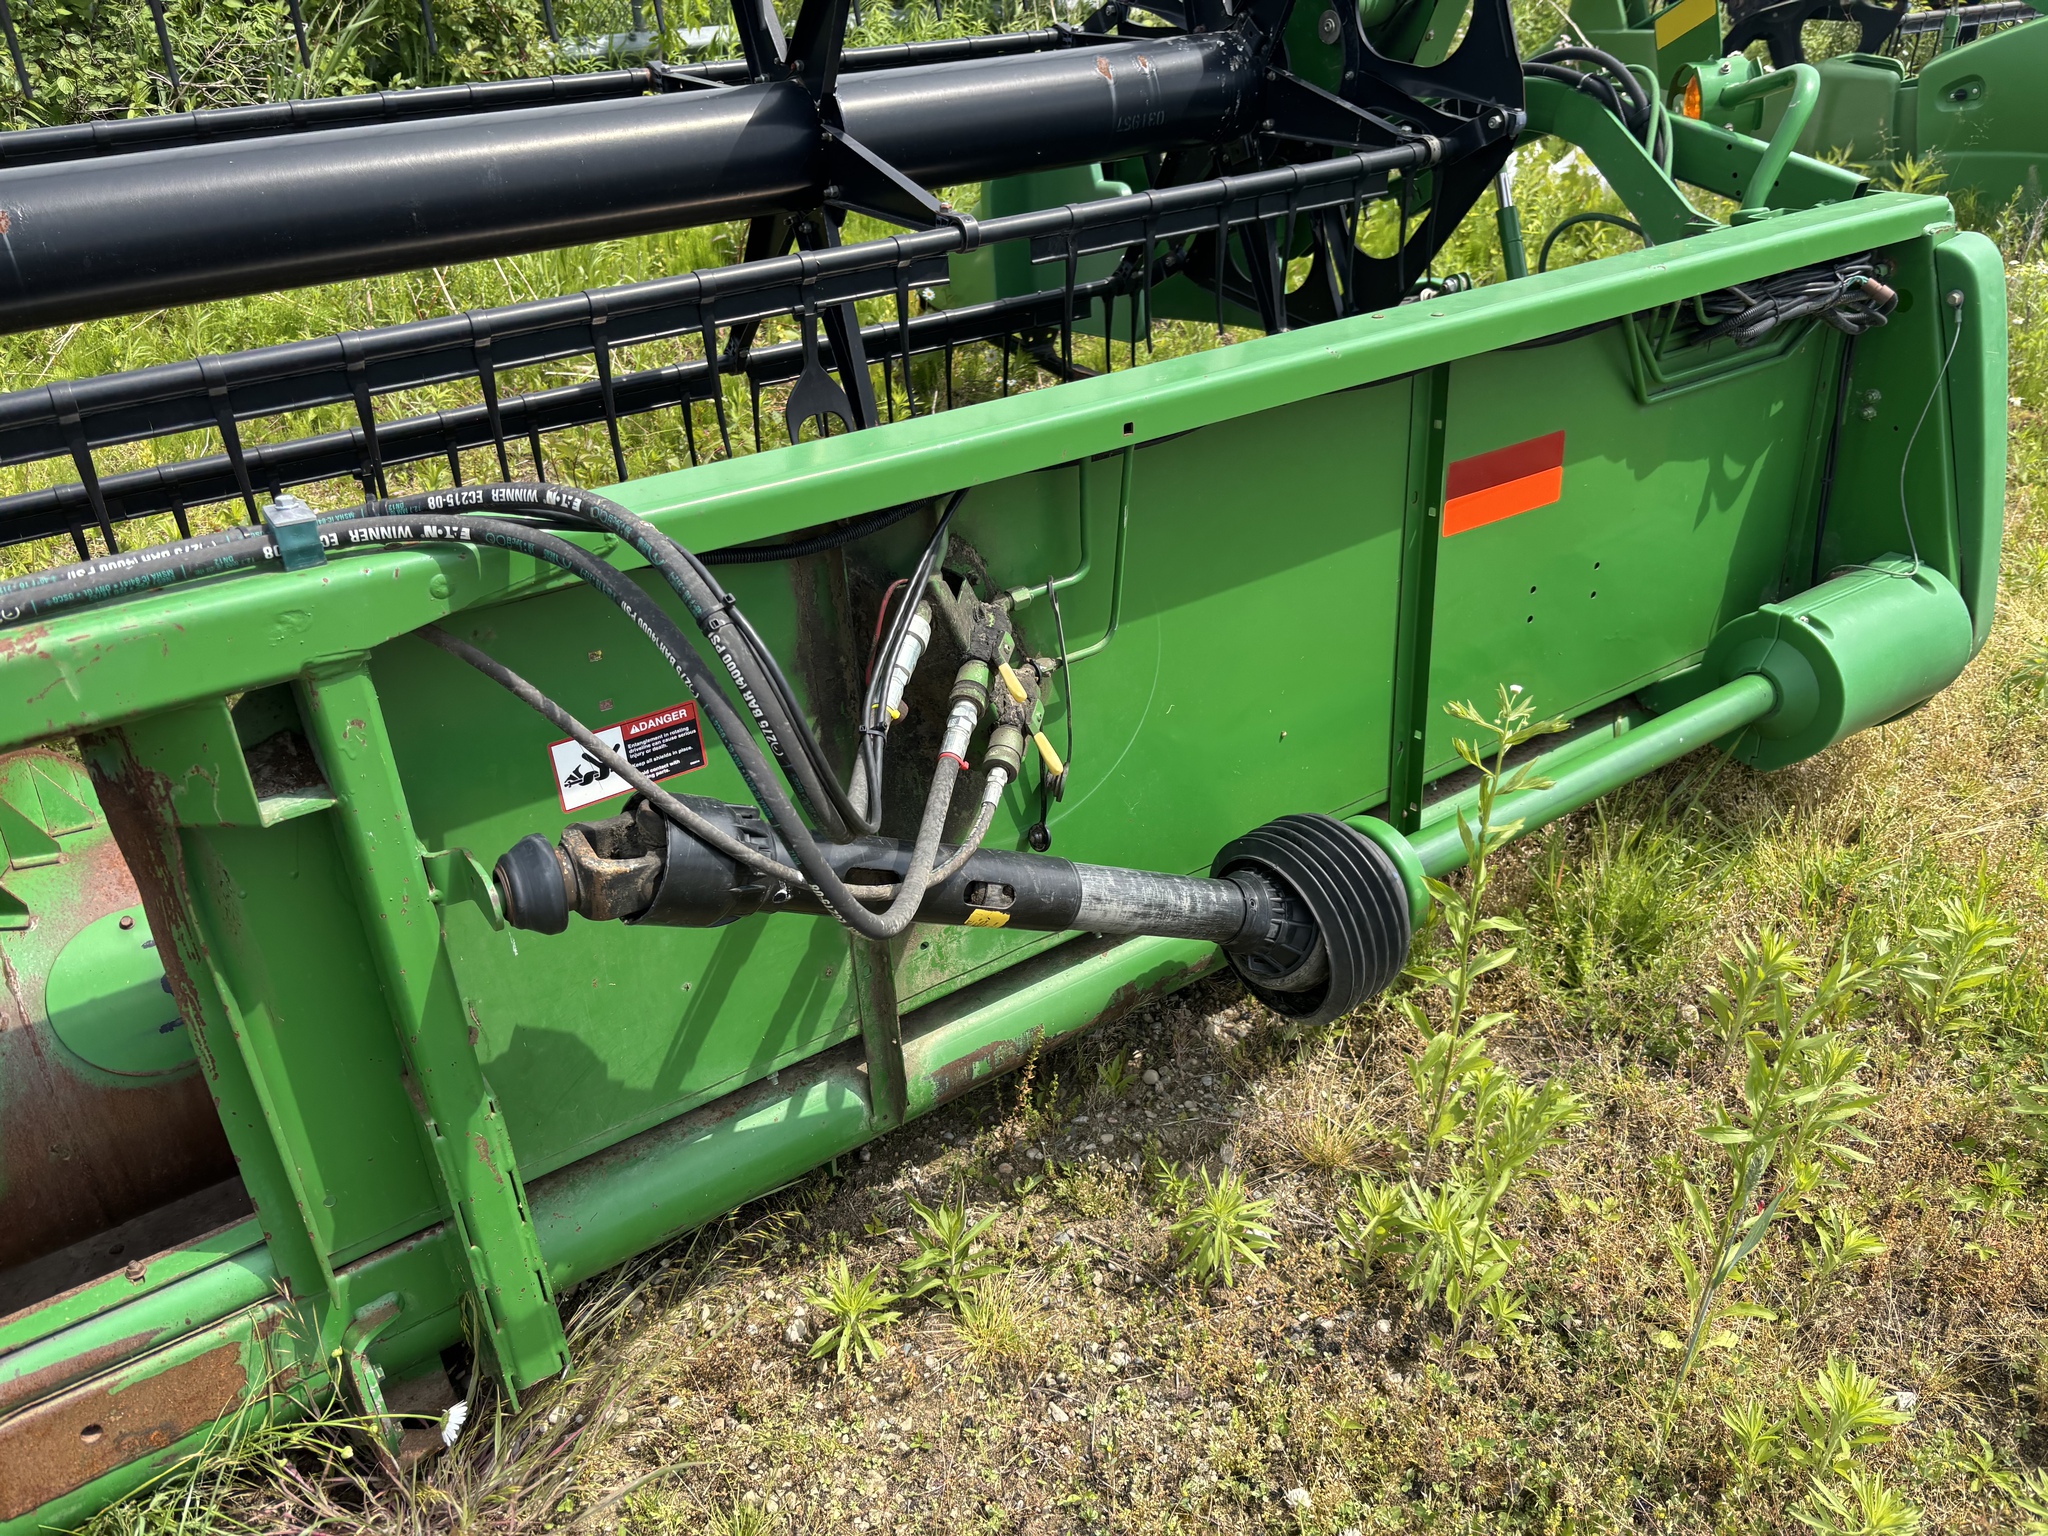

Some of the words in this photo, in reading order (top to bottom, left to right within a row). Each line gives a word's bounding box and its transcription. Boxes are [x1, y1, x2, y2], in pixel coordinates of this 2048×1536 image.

[427, 490, 484, 511] EC215-08
[491, 488, 539, 503] WINNER
[348, 525, 413, 542] WINNER
[722, 654, 748, 690] (4000
[742, 690, 763, 718] BAR
[639, 709, 688, 732] DANGER
[627, 734, 663, 749] Entanglement
[669, 726, 689, 736] rotating
[628, 743, 651, 753] driveline
[678, 729, 696, 738] serious
[757, 720, 777, 744] 275
[629, 750, 645, 759] injury
[653, 752, 671, 761] shields
[677, 745, 693, 753] place.
[649, 763, 668, 772] contact
